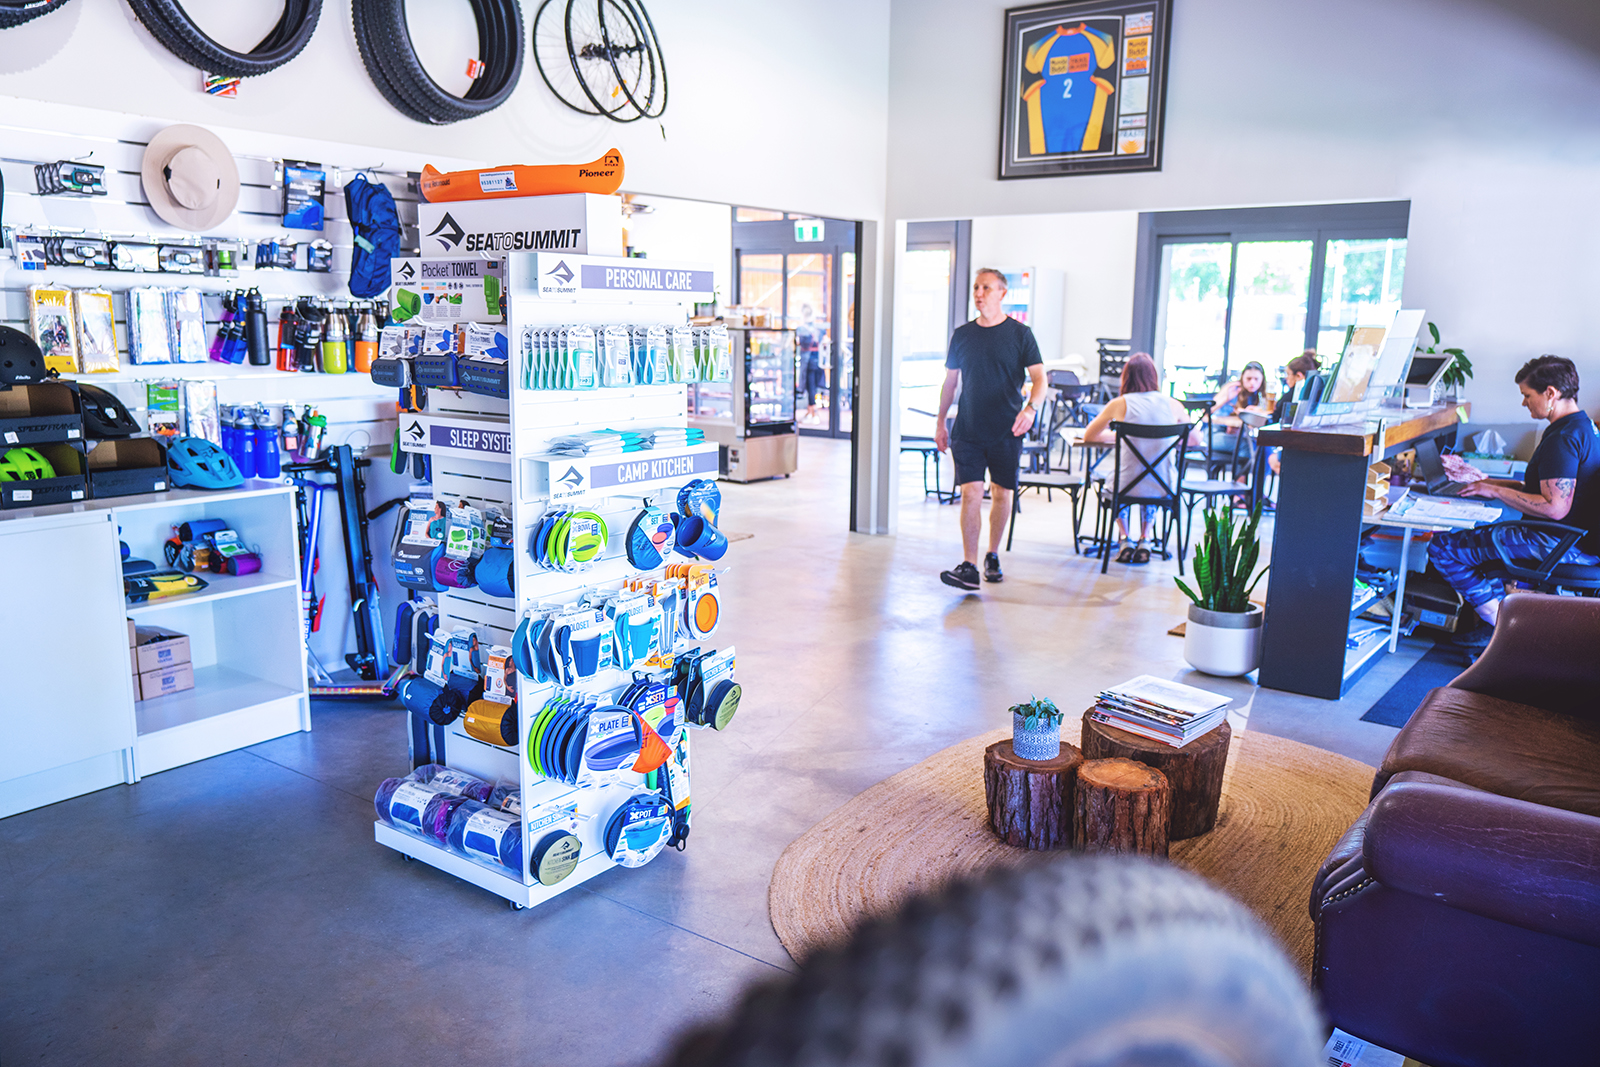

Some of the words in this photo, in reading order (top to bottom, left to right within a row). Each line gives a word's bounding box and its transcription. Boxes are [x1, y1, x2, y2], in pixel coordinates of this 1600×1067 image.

[1063, 78, 1072, 99] 2
[579, 169, 615, 177] Pioneer
[421, 263, 449, 277] Pocket
[451, 262, 479, 277] TOWEL
[605, 268, 663, 289] PERSONAL
[665, 271, 692, 290] CARE
[450, 428, 479, 449] SLEEP
[617, 461, 649, 483] CAMP
[651, 456, 694, 478] KITCHEN
